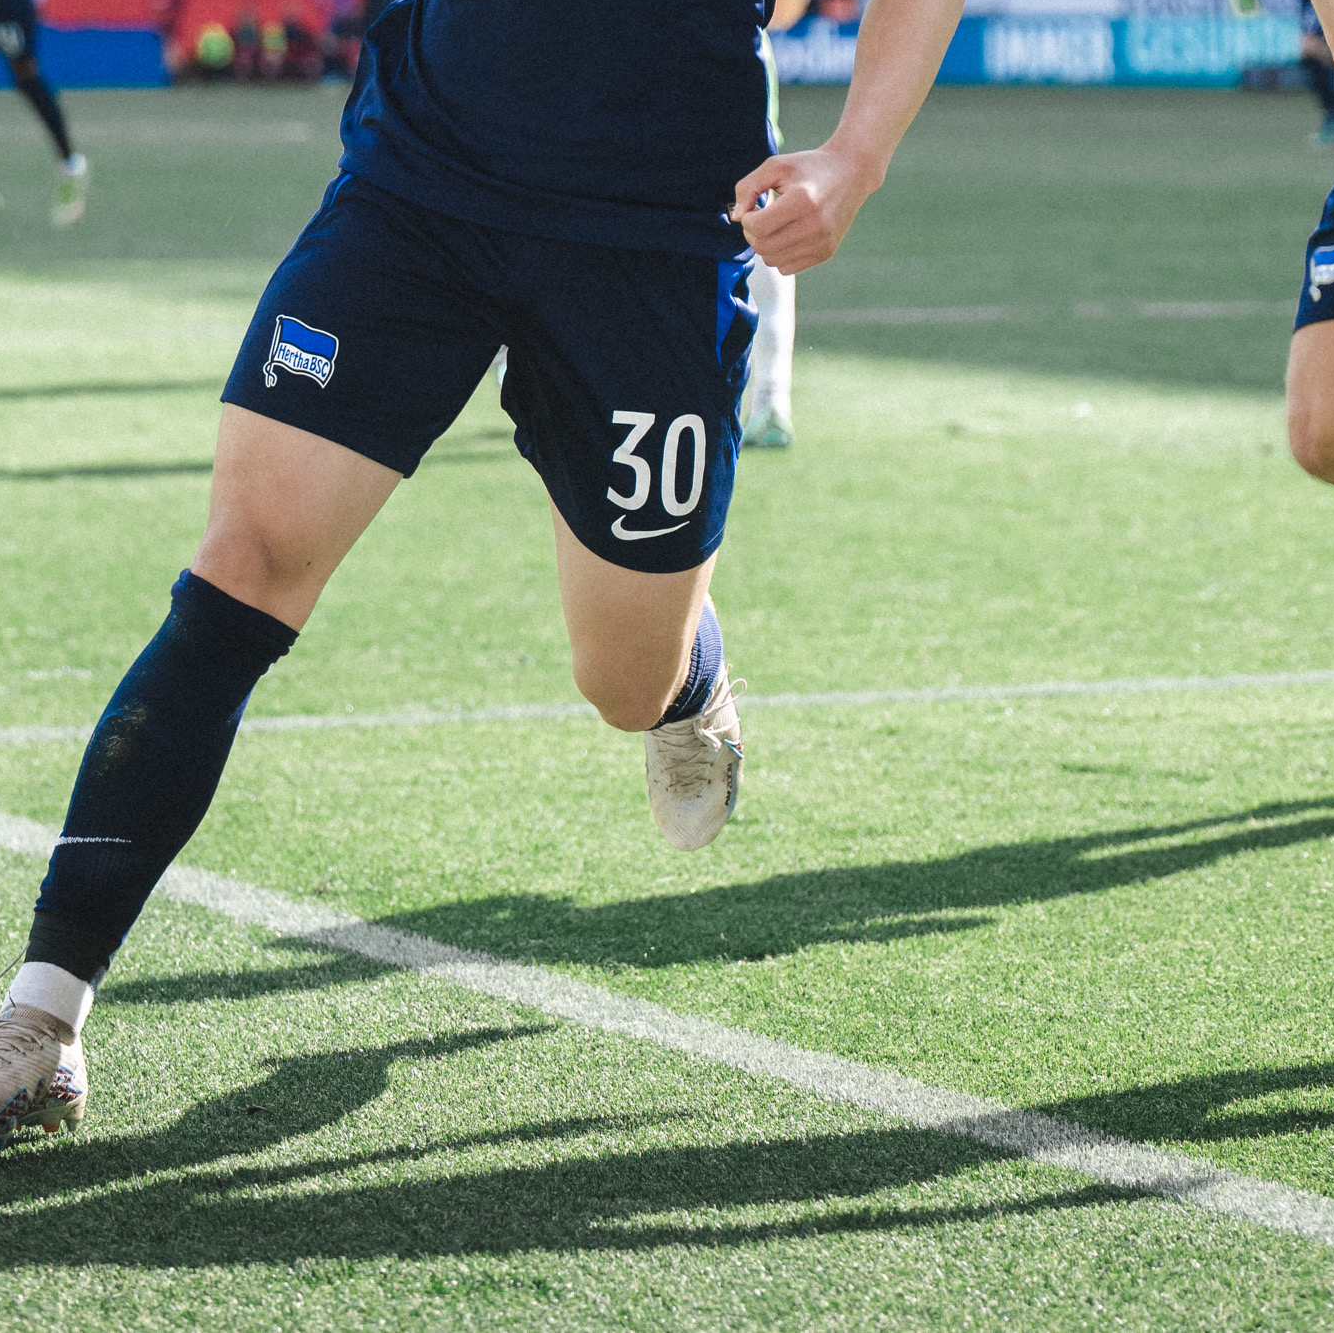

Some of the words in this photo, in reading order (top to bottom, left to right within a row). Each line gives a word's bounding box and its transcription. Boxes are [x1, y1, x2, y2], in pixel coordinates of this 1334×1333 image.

[277, 344, 309, 370] Hertha
[309, 356, 329, 378] BSC
[606, 410, 707, 517] 30
